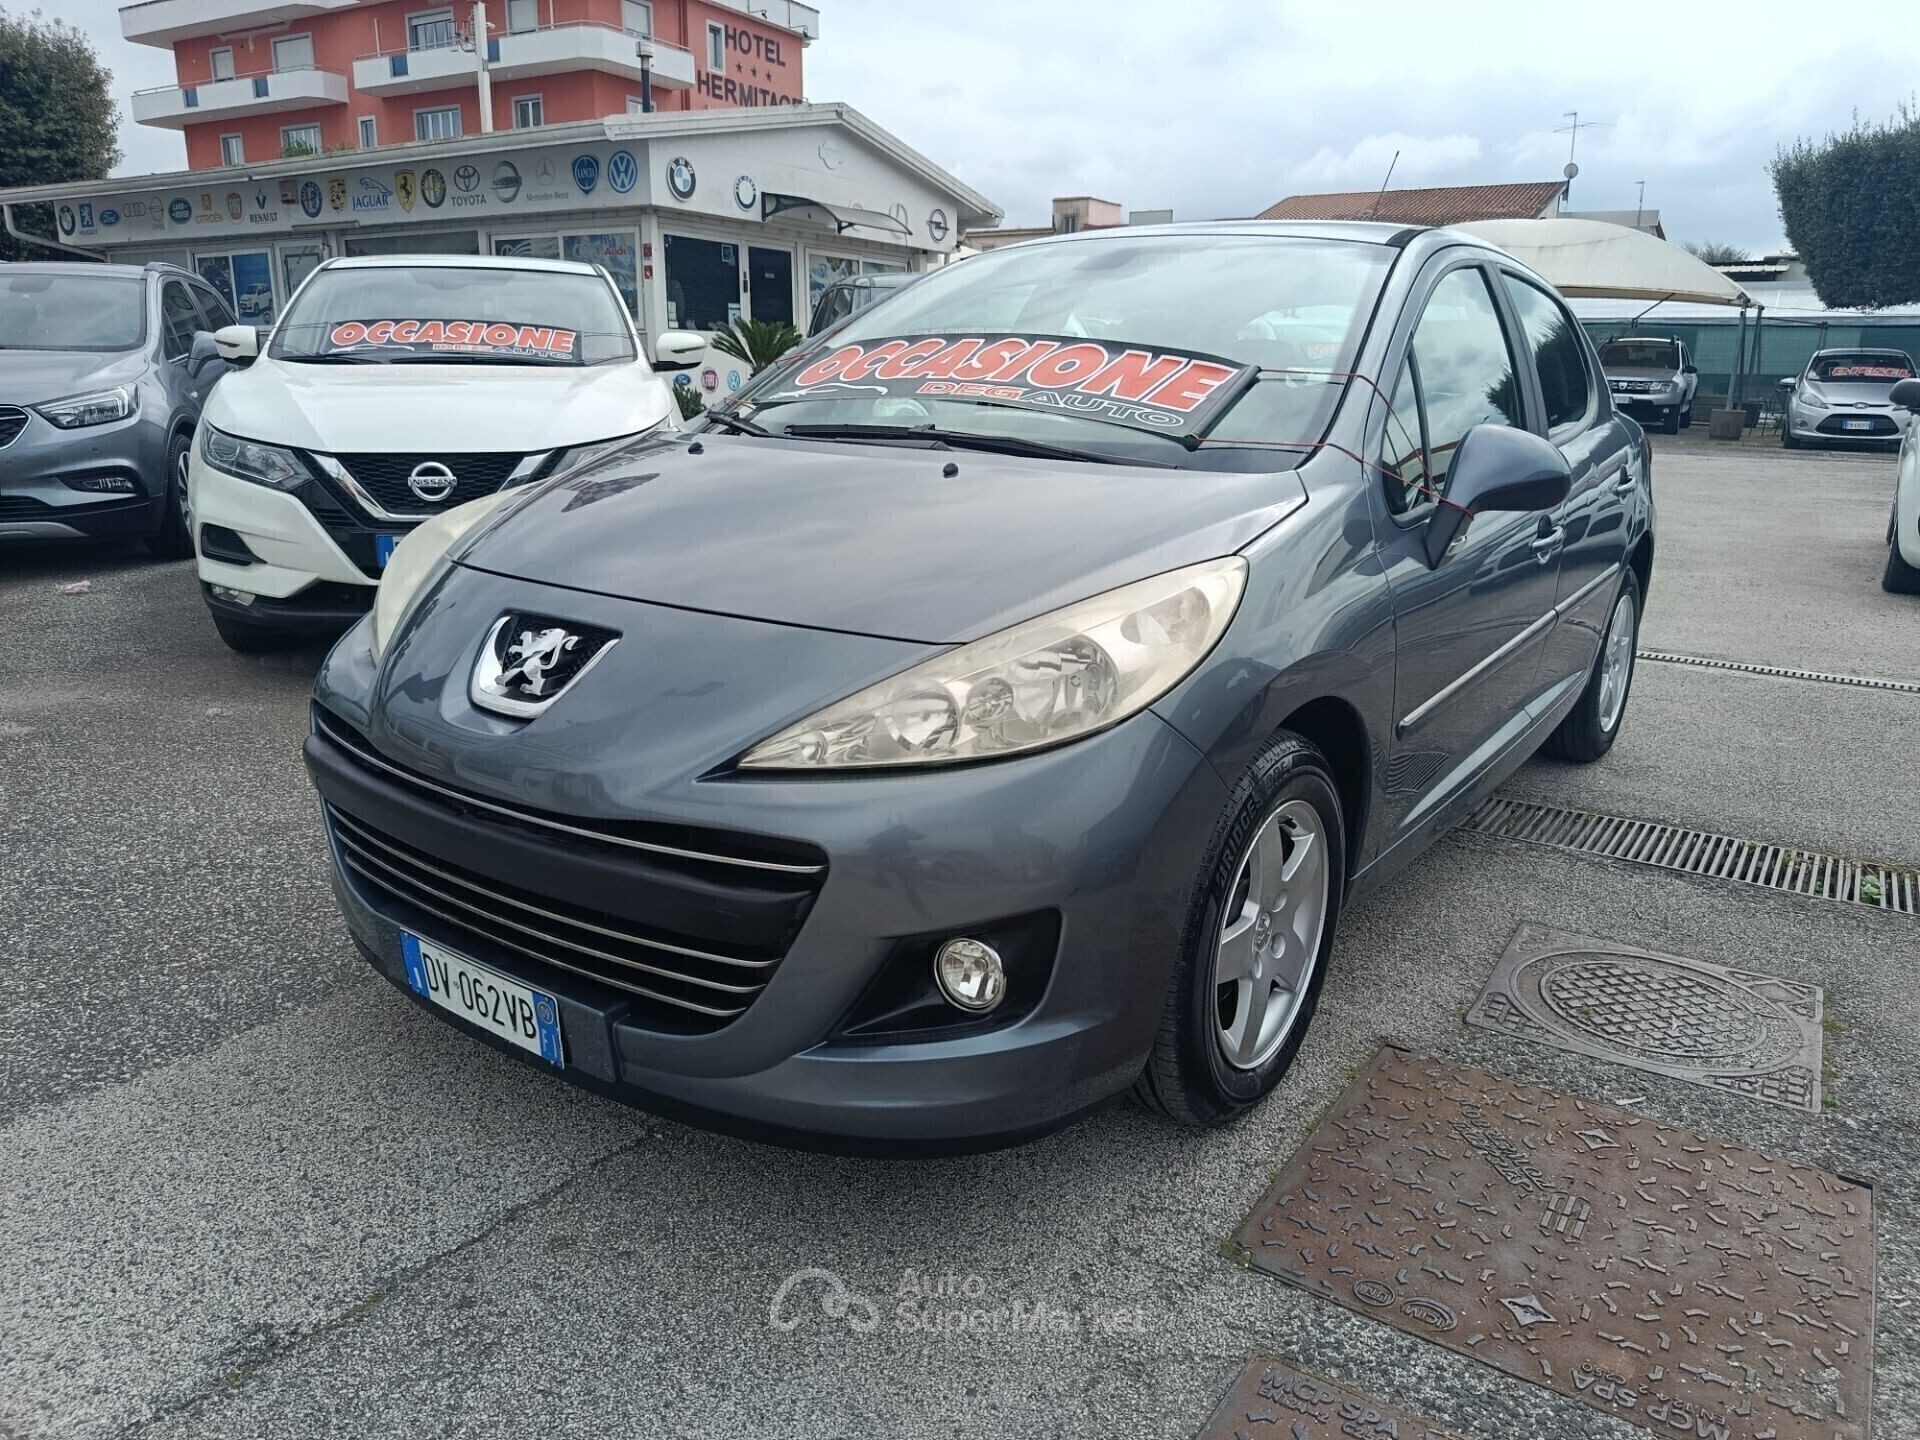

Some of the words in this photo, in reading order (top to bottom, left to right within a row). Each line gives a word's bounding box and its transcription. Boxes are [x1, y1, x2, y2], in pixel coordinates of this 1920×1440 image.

[724, 24, 786, 67] HOTEL
[697, 69, 803, 107] HERMITA
[249, 212, 278, 224] RENAULT
[352, 194, 389, 211] JAGUAR
[451, 194, 487, 207] TOYOTA
[331, 320, 577, 352] OCCASIONE
[794, 337, 1238, 412] OCCASIONE
[410, 478, 455, 487] NISSAN
[422, 952, 451, 999] DV
[458, 971, 537, 1039] 062VB
[1261, 1369, 1336, 1405] MCP
[1338, 1400, 1400, 1439] SPA
[1569, 1367, 1638, 1408] SPA
[1646, 1404, 1731, 1440] MCP
